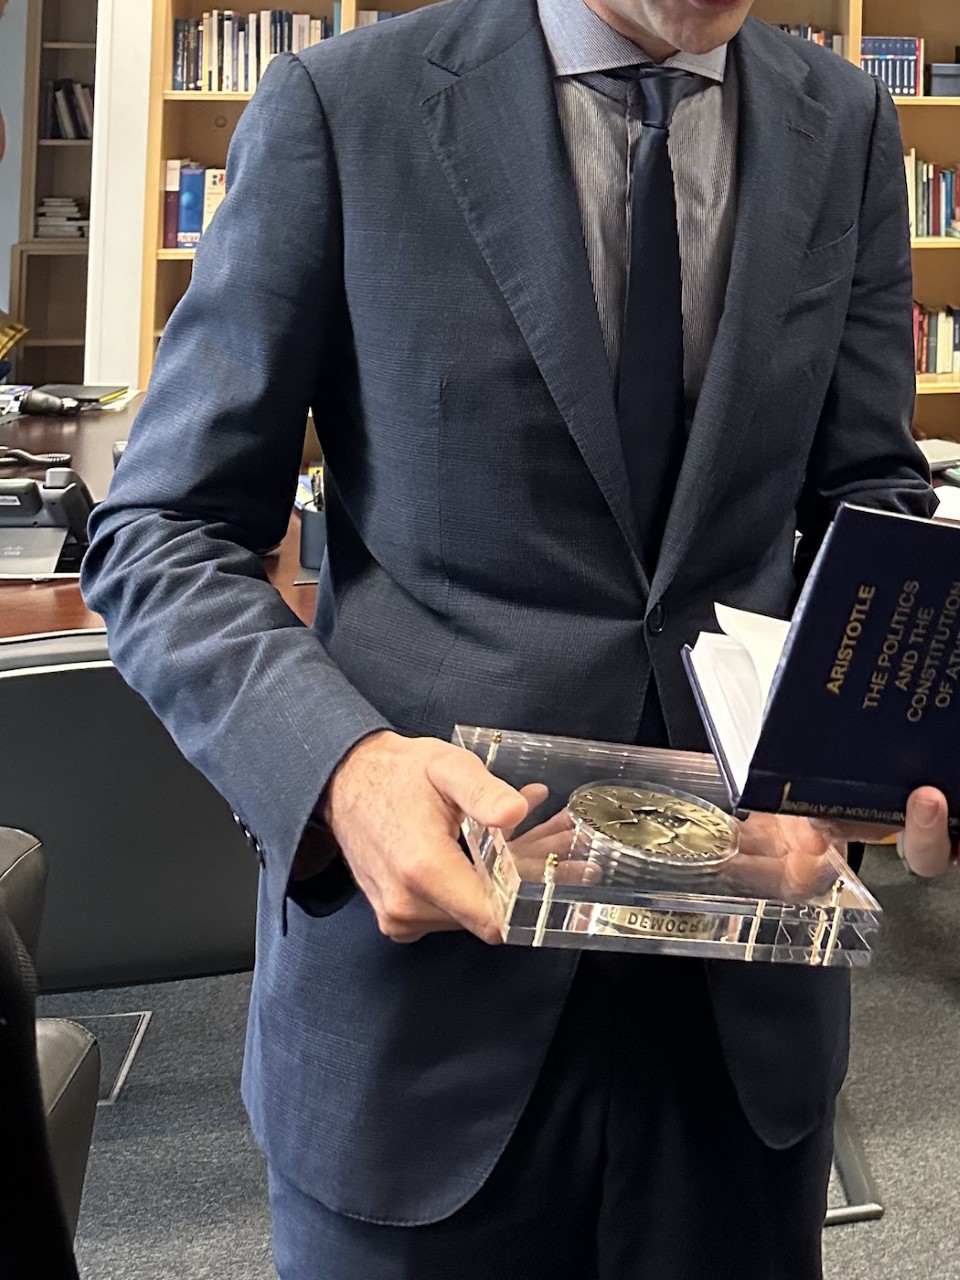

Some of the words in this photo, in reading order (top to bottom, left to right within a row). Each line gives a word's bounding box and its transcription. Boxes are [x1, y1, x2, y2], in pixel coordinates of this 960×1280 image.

[826, 585, 876, 695] ARISTOTLE
[862, 671, 889, 709] THE
[878, 580, 920, 668] POLITICS
[895, 650, 918, 691] AND
[909, 607, 935, 645] THE
[935, 681, 953, 708] OF
